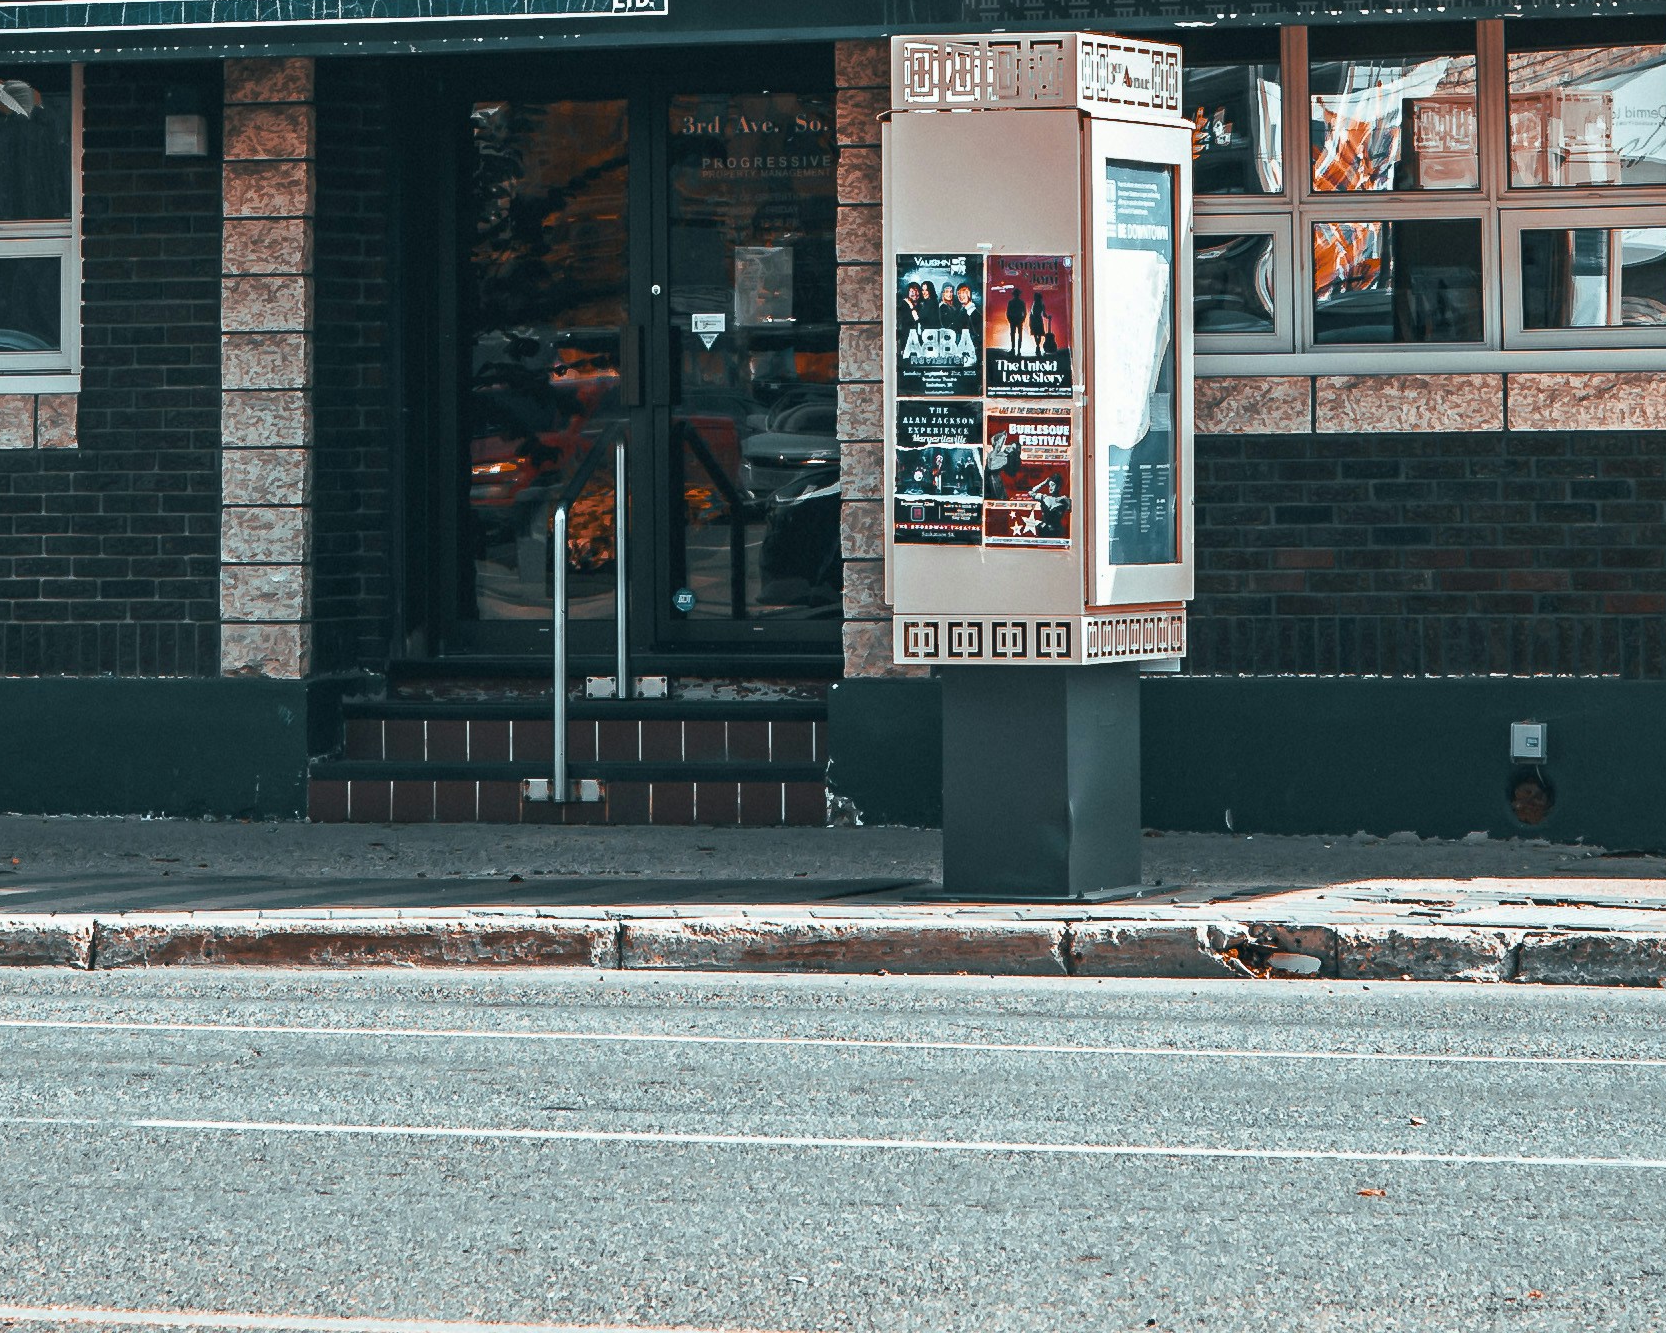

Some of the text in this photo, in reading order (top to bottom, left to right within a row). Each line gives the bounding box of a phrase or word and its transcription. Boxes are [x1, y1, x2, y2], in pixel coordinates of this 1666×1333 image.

[683, 112, 829, 133] 3rd Ave. So.
[701, 155, 832, 169] PROGRESSIVE
[701, 168, 832, 179] PROPERTY MANAGEMENT
[902, 327, 978, 359] ABBA
[995, 359, 1058, 372] The Untold
[1002, 371, 1065, 386] Love Story
[929, 406, 949, 414] THE
[902, 416, 976, 425] ALAN JACKSON
[907, 426, 970, 435] EXPERIENCE
[1008, 423, 1070, 436] BURLESQUE
[1018, 434, 1069, 446] FESTIVAL
